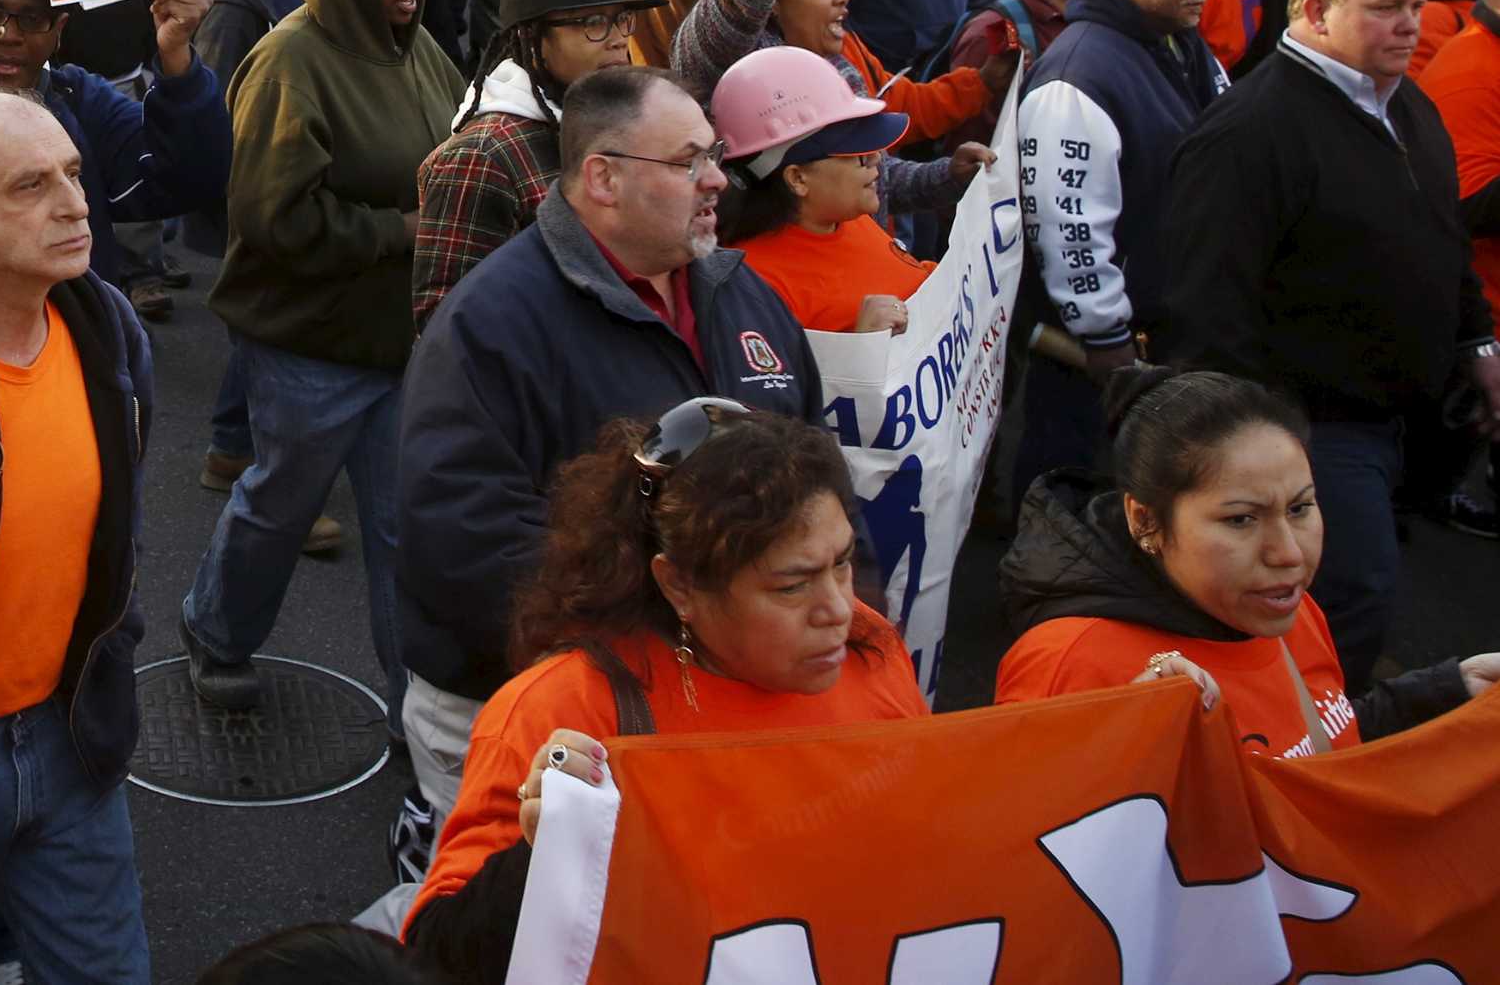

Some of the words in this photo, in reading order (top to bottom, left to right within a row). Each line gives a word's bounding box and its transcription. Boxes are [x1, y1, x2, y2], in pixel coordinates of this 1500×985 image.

[1060, 139, 1090, 161] '50
[1057, 168, 1087, 188] '47
[1056, 195, 1085, 216] '41
[1059, 222, 1091, 242] '38
[1062, 248, 1095, 269] '36
[1067, 274, 1101, 295] '28
[823, 264, 973, 451] ABORERS'
